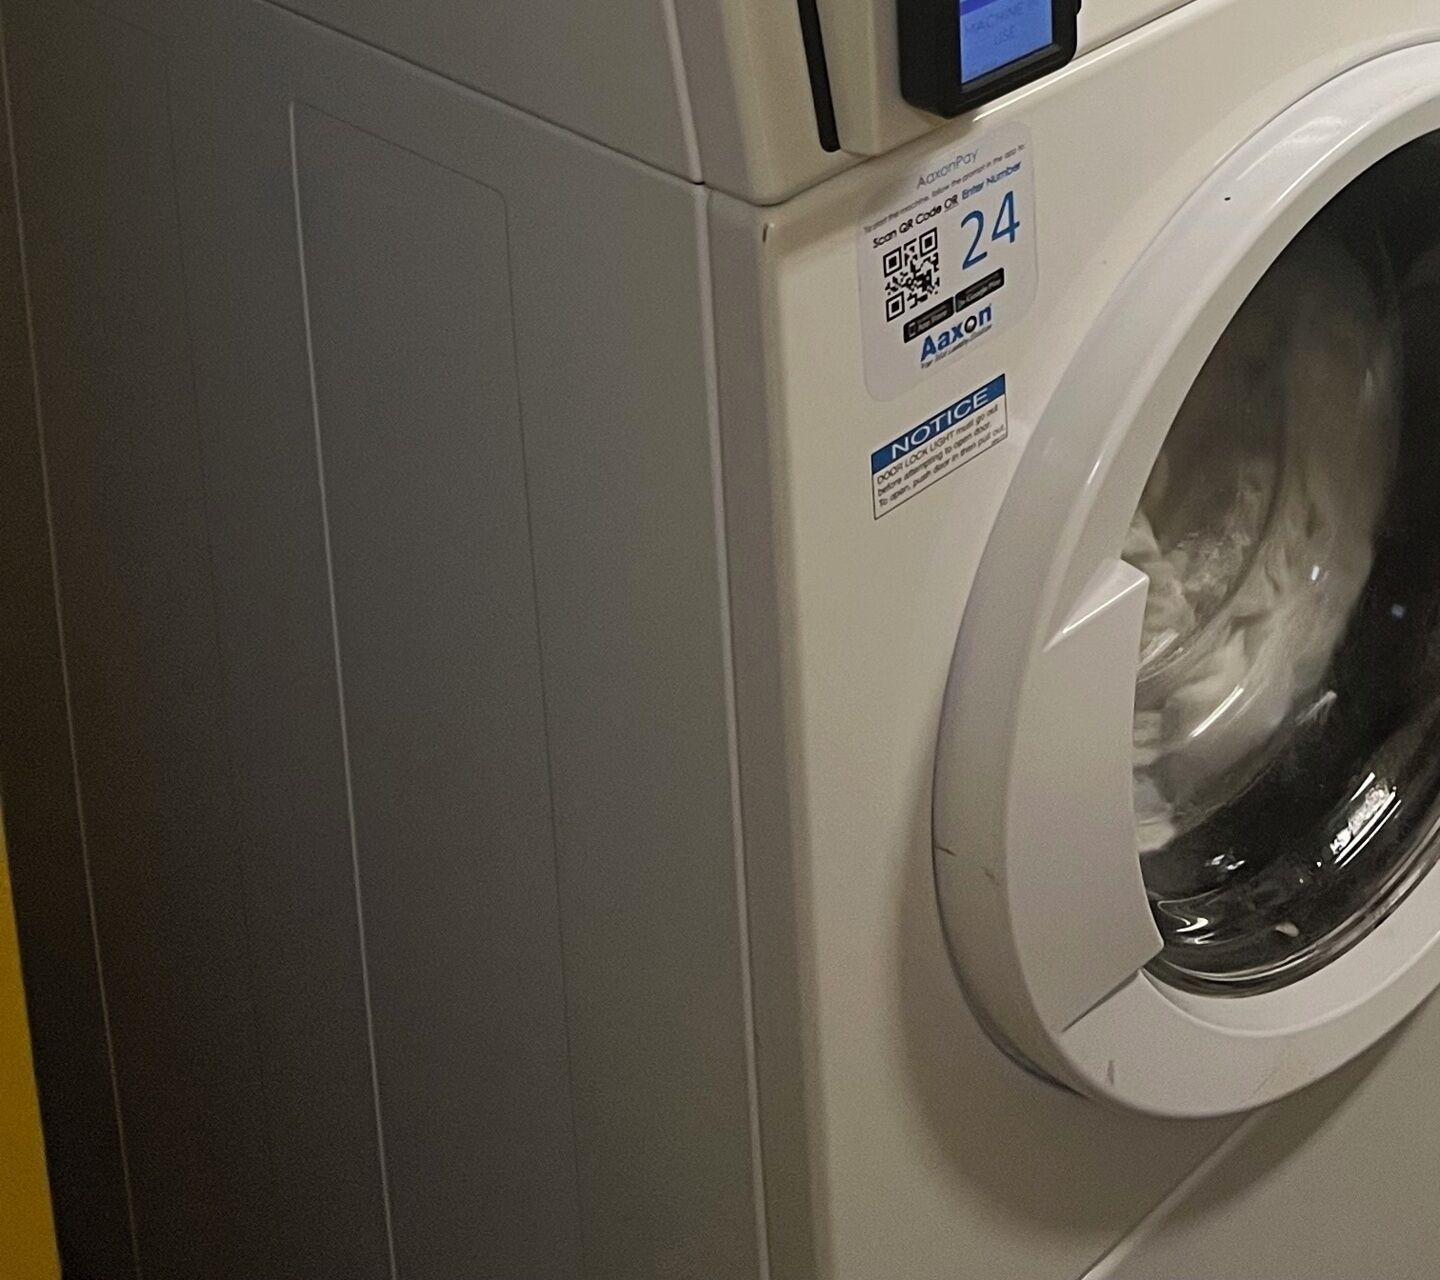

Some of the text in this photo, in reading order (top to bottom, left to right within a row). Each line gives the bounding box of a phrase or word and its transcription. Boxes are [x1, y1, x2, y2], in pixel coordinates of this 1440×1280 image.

[916, 148, 978, 189] AaxonPay
[873, 162, 1021, 249] Scan QR Code OR Enter Number
[961, 191, 1020, 270] 24
[921, 306, 991, 362] Aaxon
[892, 388, 988, 459] NOTICE
[877, 462, 903, 485] DOOR
[905, 448, 928, 467] LOCK
[930, 432, 954, 453] LIGHT
